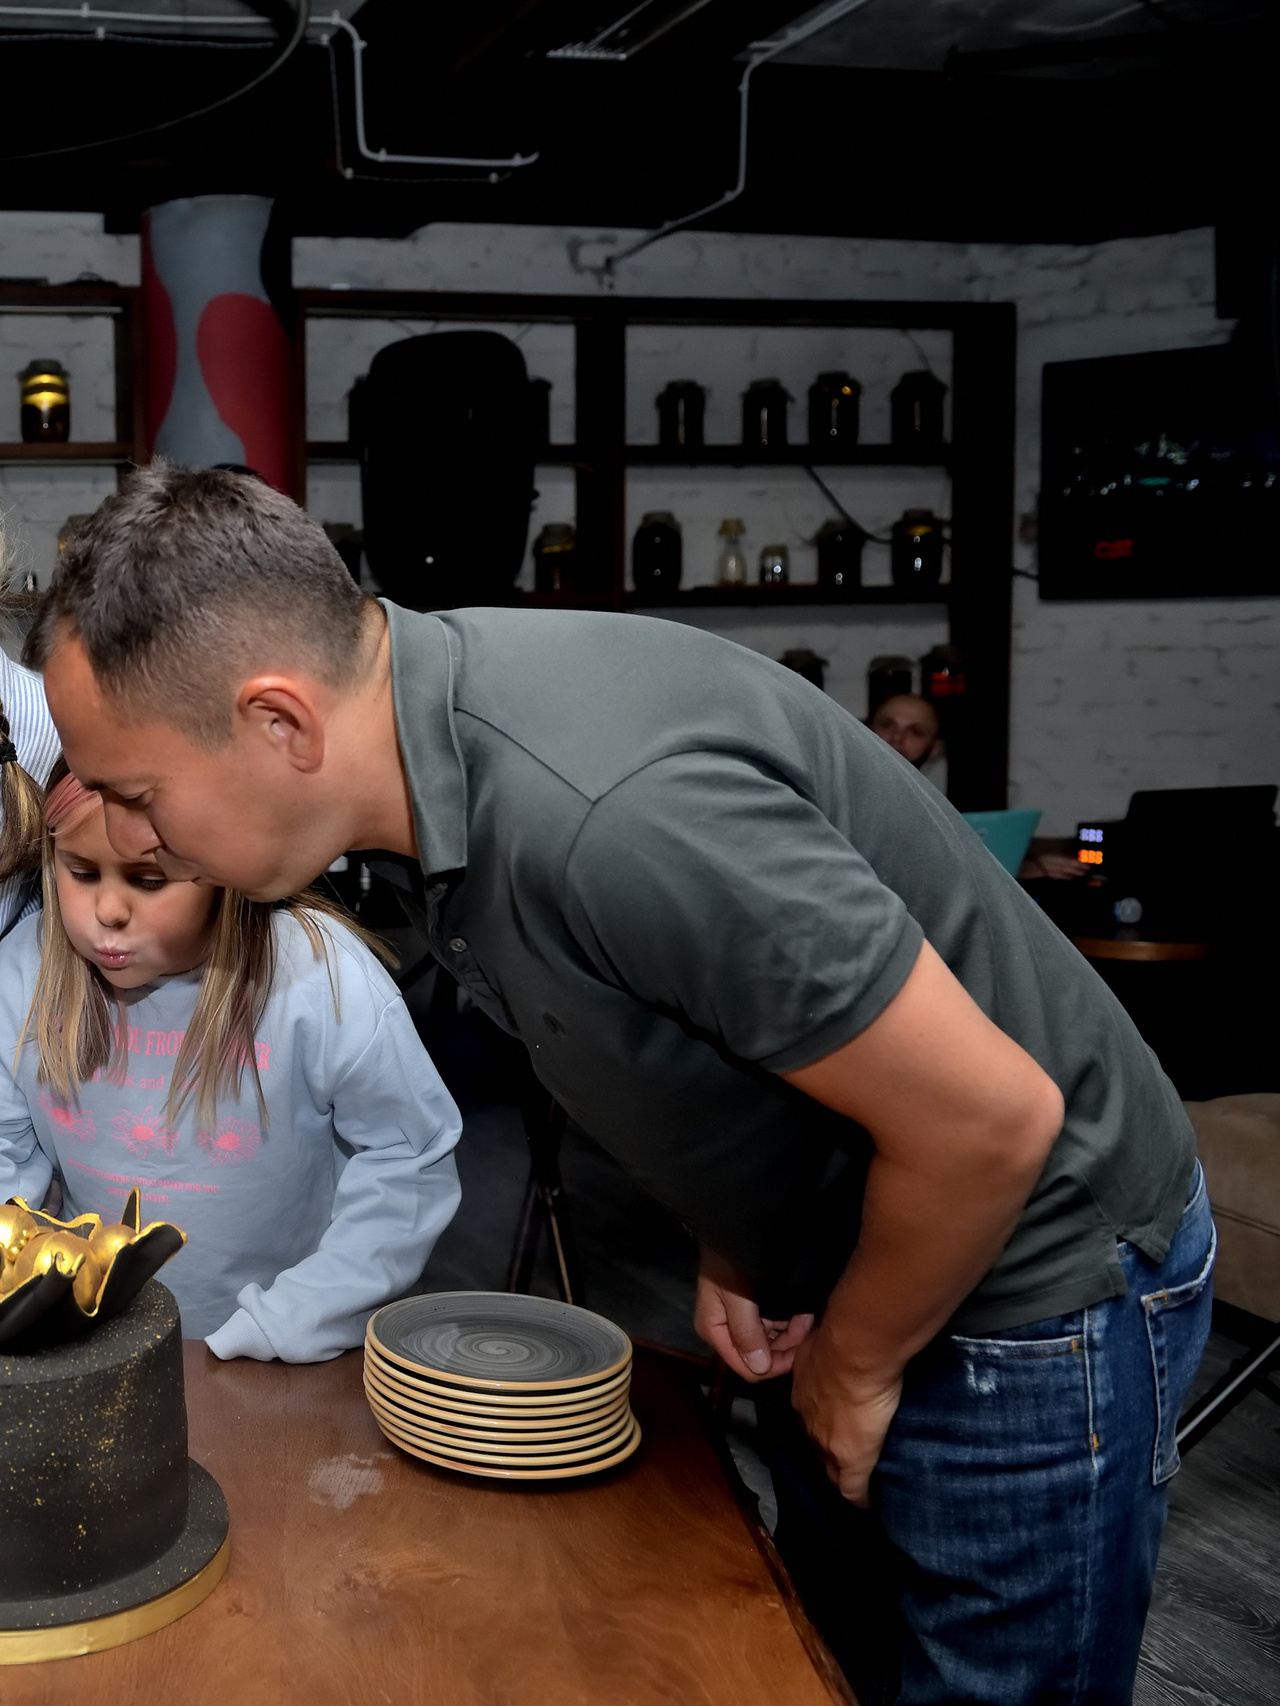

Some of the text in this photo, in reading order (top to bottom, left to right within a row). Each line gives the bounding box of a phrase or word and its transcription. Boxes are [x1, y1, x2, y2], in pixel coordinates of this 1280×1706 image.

[145, 1029, 187, 1057] FRO
[139, 1073, 166, 1090] and
[131, 1175, 148, 1187] AND
[148, 1177, 184, 1191] SUMMER
